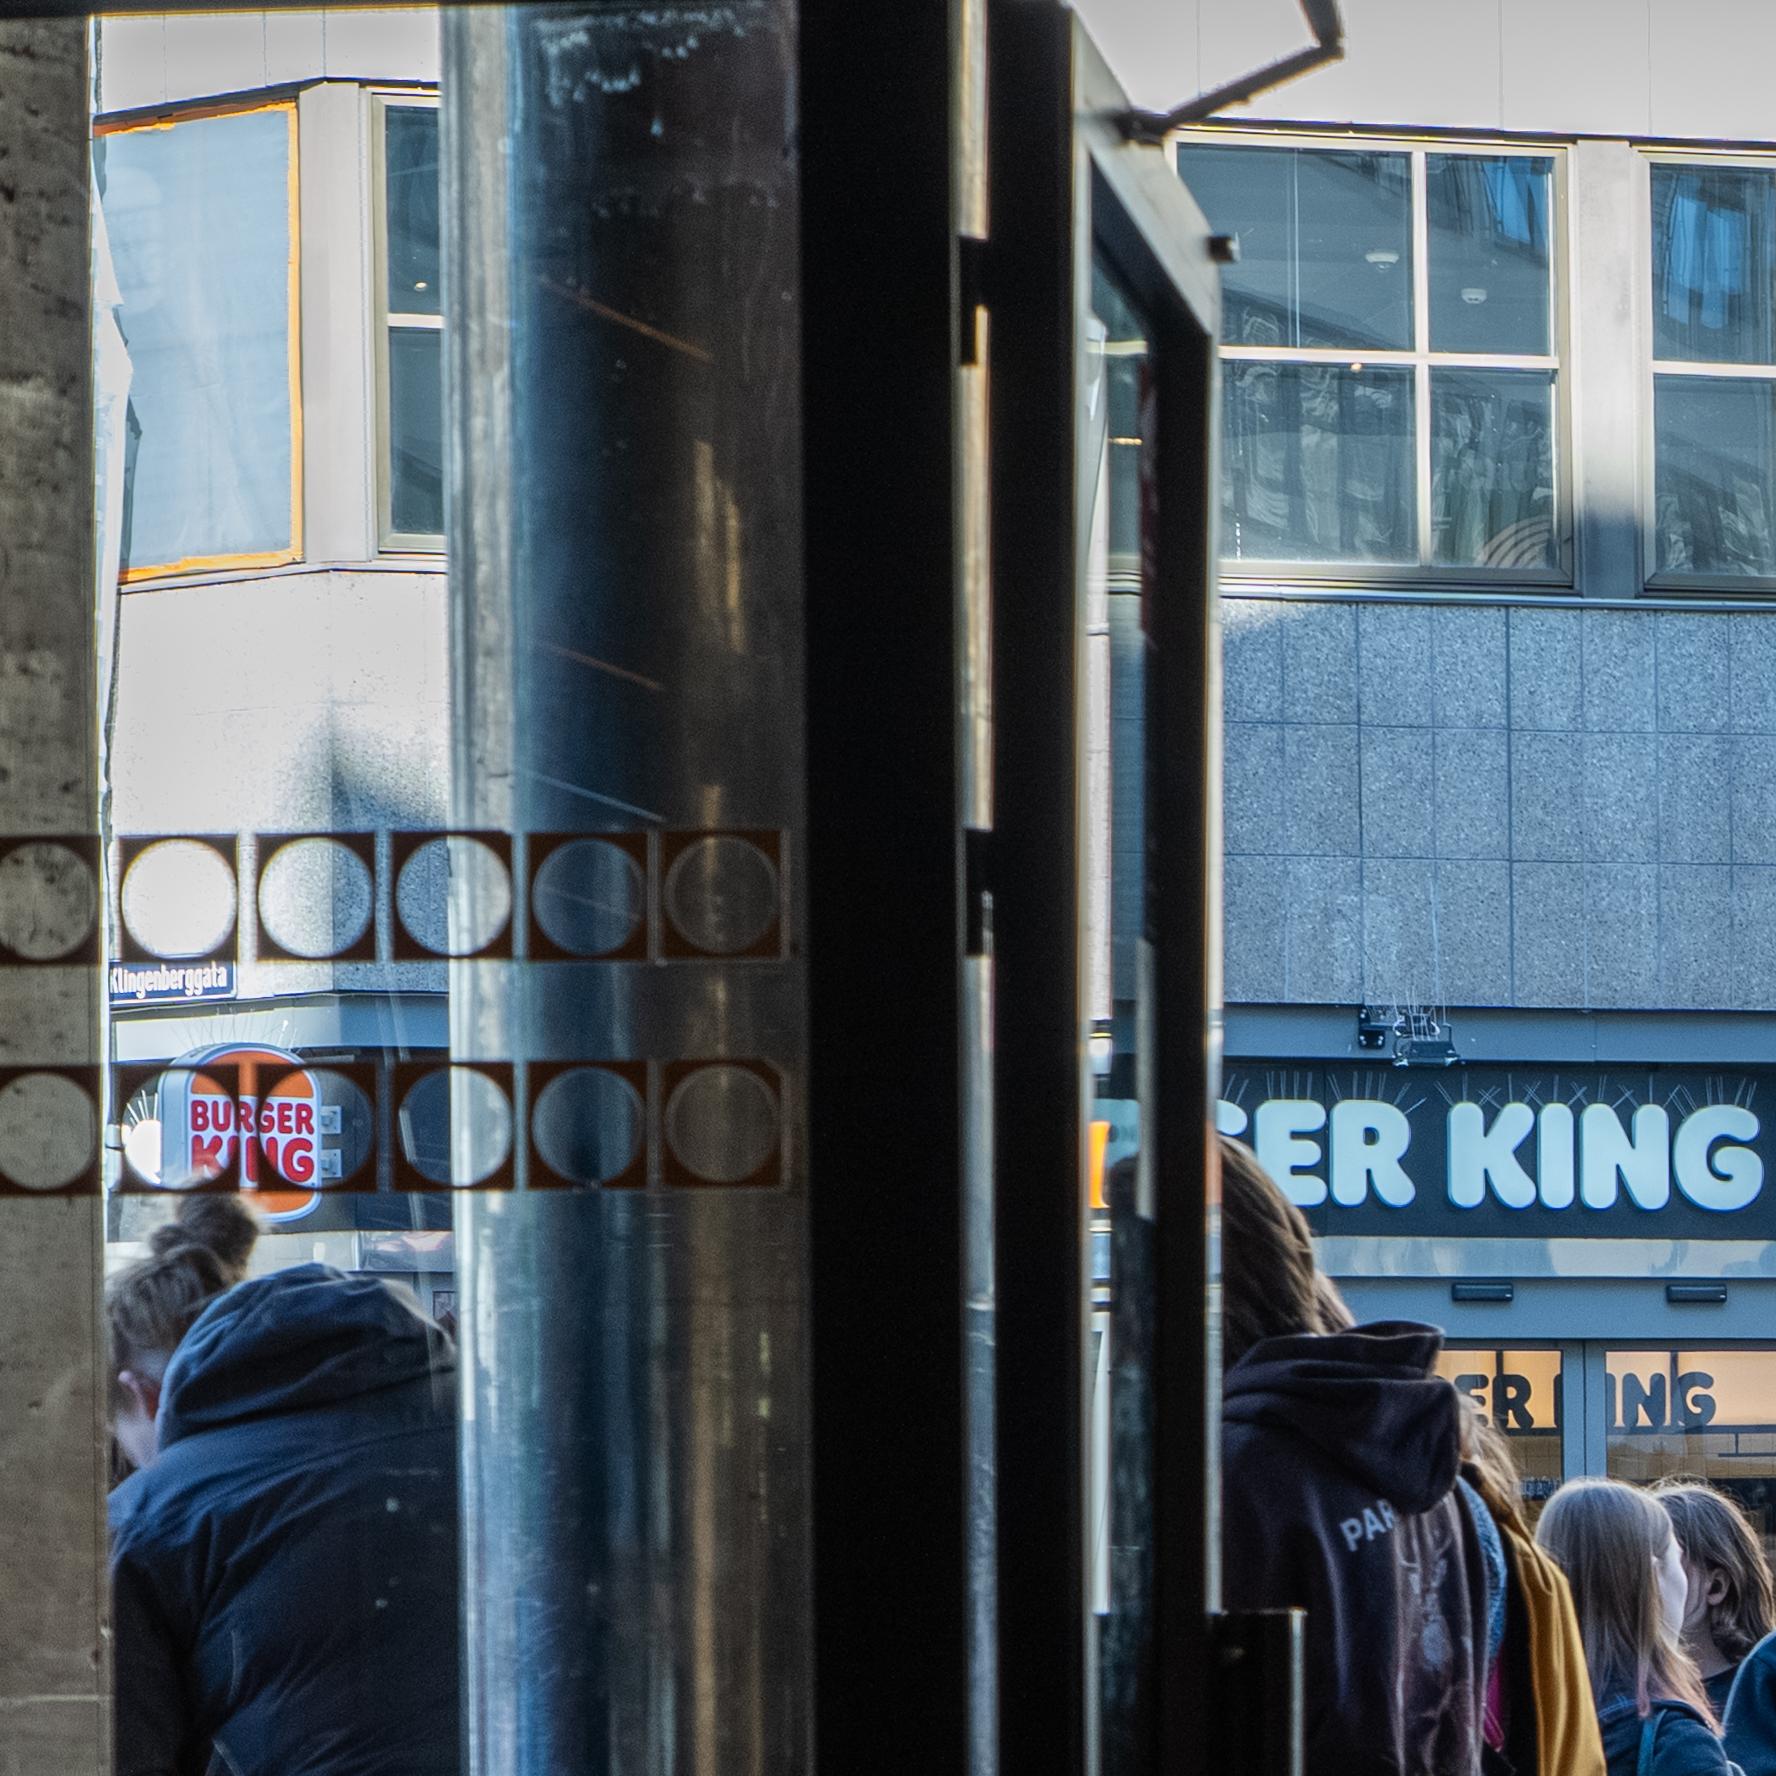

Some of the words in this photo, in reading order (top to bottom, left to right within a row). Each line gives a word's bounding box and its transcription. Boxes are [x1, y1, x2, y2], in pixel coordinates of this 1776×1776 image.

[110, 962, 228, 998] Klingenberggata
[191, 1099, 314, 1136] BURGER
[191, 1134, 315, 1184] KING
[1217, 1099, 1416, 1208] ER
[1446, 1101, 1764, 1212] KING
